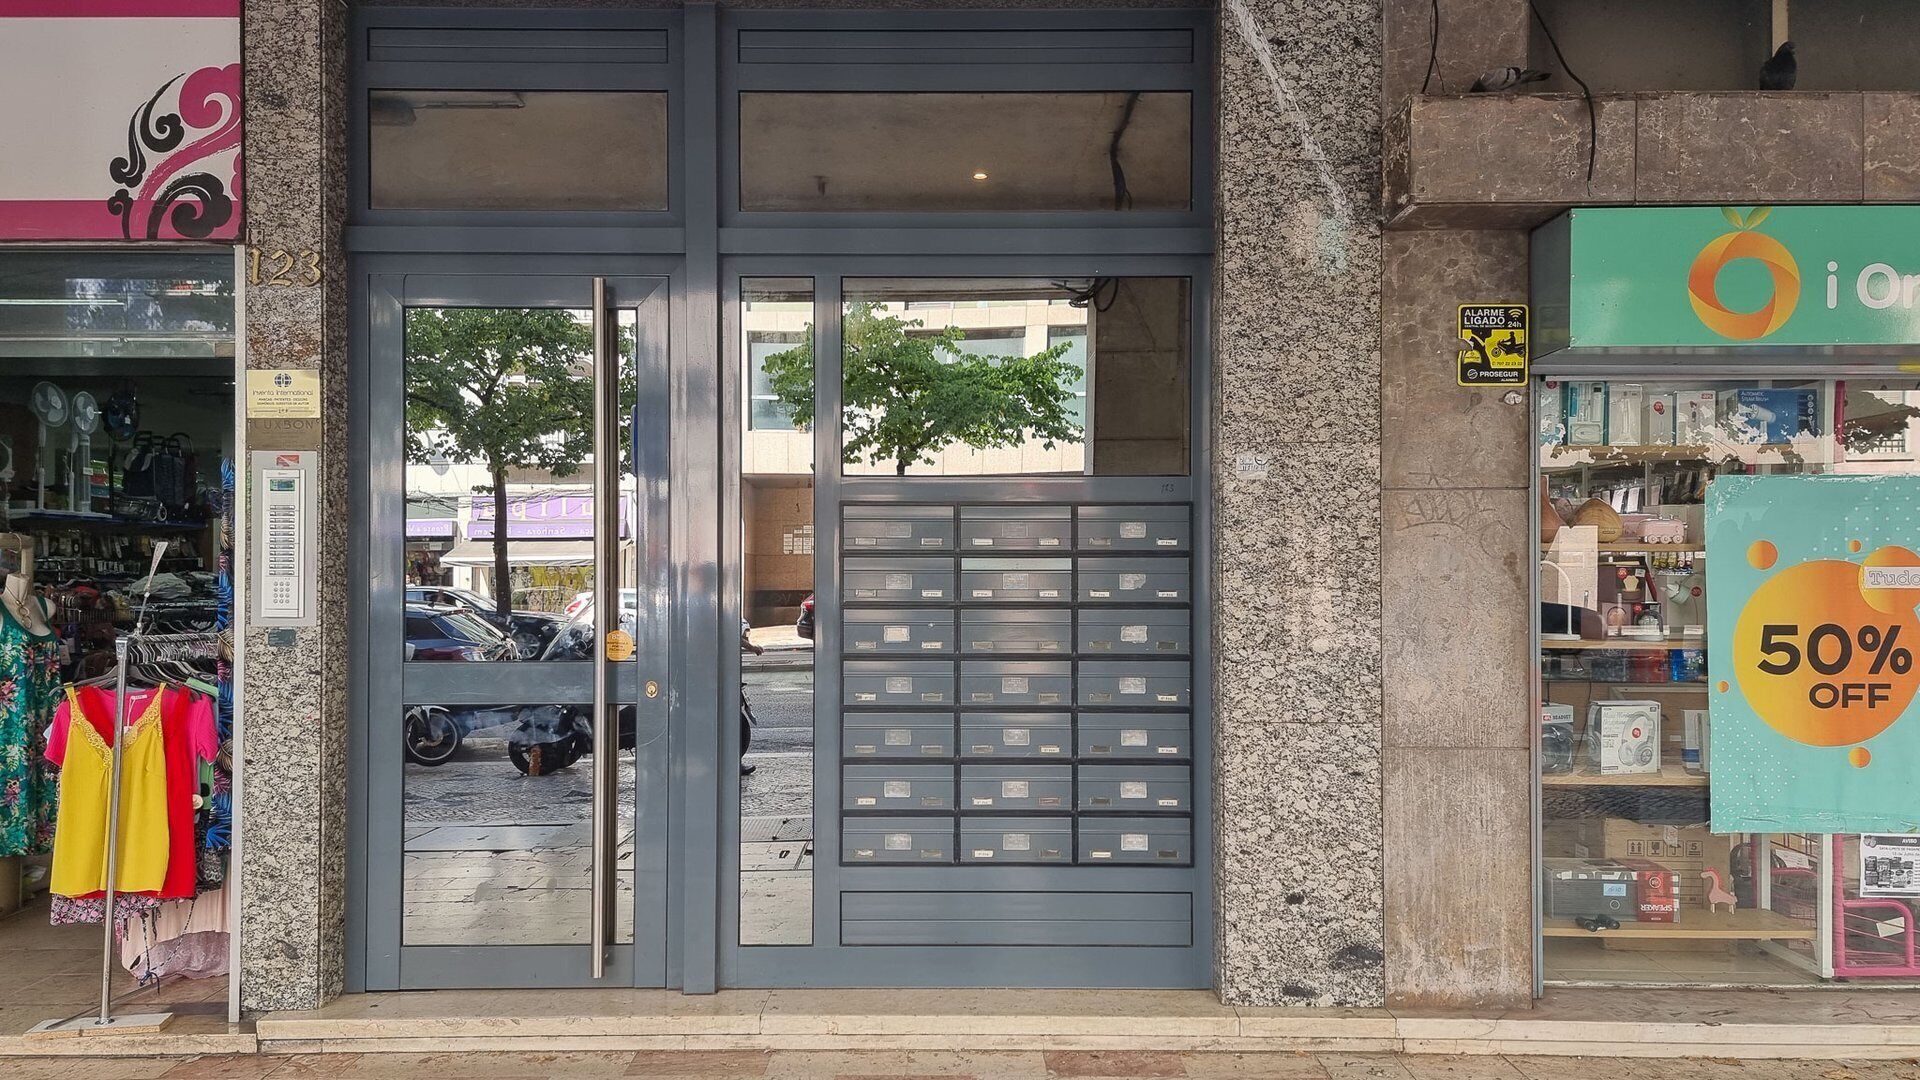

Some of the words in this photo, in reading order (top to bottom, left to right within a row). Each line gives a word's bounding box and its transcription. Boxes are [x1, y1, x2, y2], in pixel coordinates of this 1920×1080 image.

[248, 247, 322, 287] 123
[1827, 261, 1838, 309] i
[1464, 309, 1505, 317] ALARME
[1464, 317, 1505, 325] LIGADO
[1757, 624, 1913, 676] 50%
[1809, 682, 1892, 709] OFF
[1691, 843, 1698, 851] 5
[1640, 904, 1673, 912] SPEAKER
